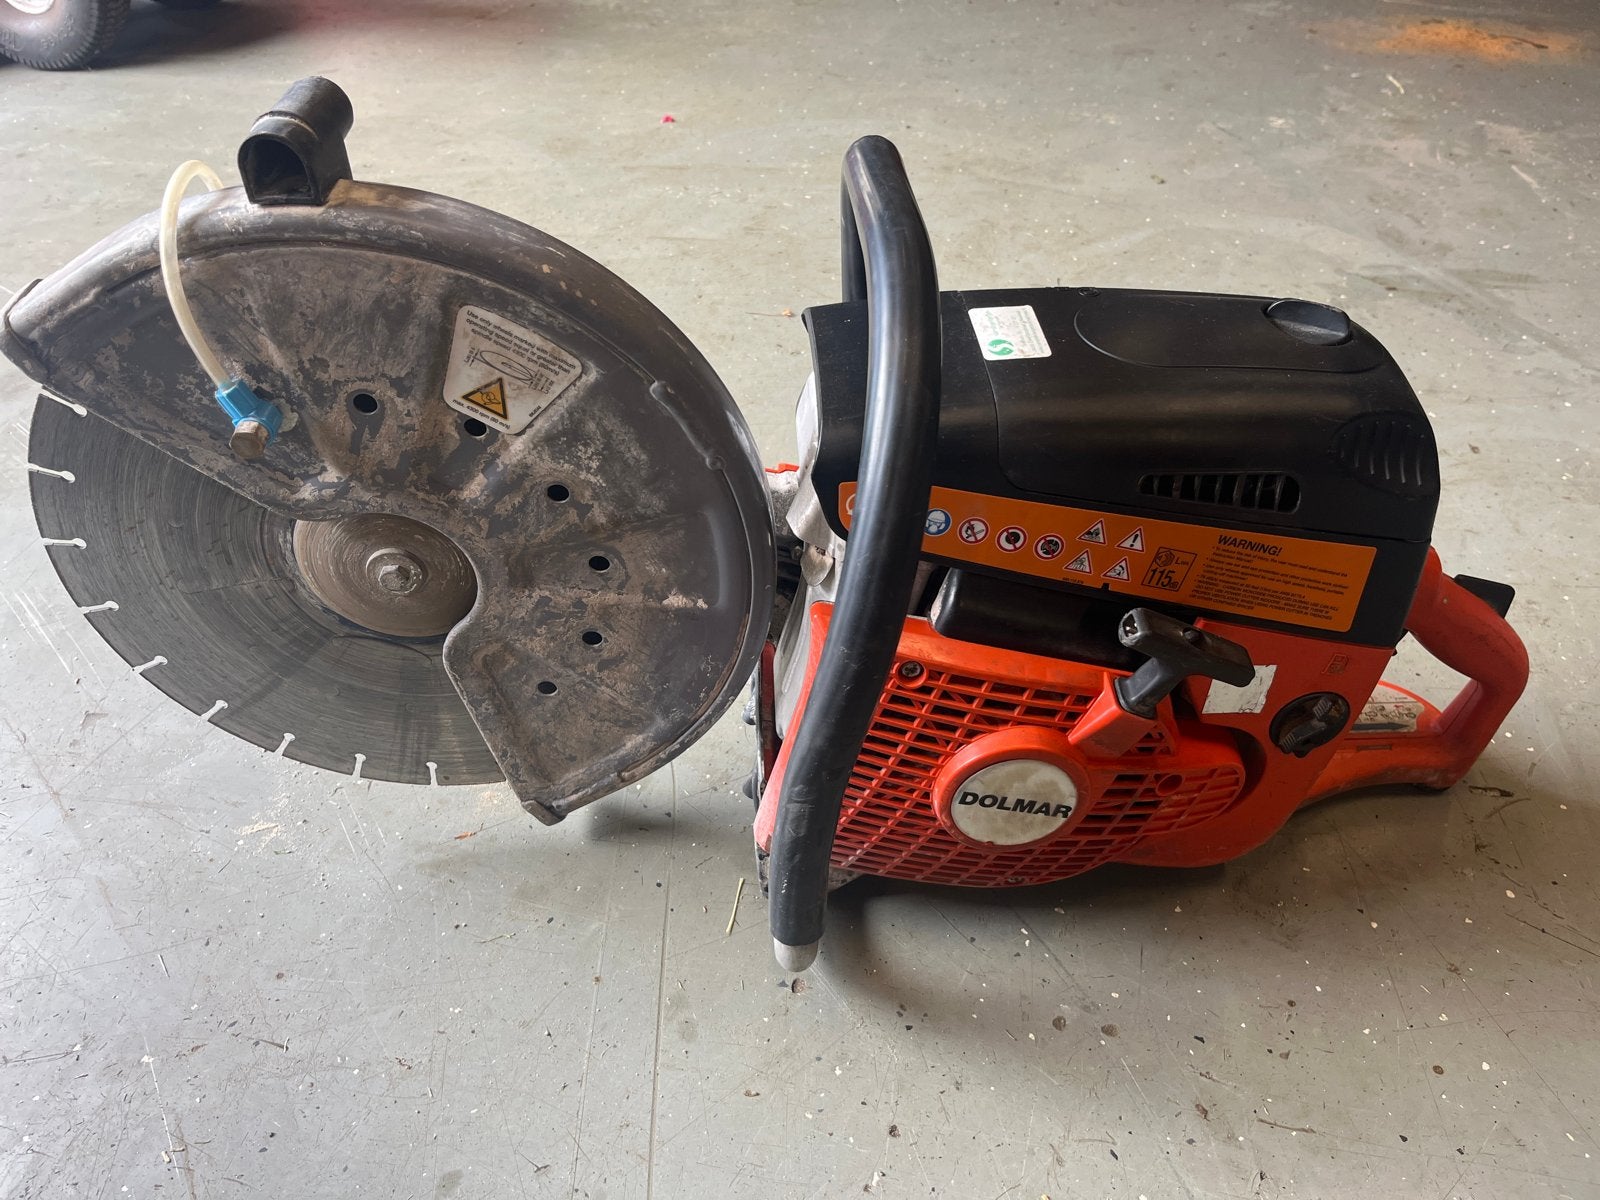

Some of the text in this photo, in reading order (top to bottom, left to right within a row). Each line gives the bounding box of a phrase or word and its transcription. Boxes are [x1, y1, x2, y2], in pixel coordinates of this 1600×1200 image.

[466, 318, 494, 335] operating
[495, 333, 513, 345] speed
[513, 342, 530, 353] equal
[537, 354, 558, 367] greater
[557, 364, 571, 374] than
[467, 310, 576, 370] Use only wheels marked with maximum
[471, 328, 492, 341] spindle
[493, 339, 512, 351] speed
[527, 356, 538, 365] rpm
[453, 399, 465, 408] max.
[466, 405, 479, 414] 4300
[479, 411, 490, 420] rpm
[1218, 535, 1283, 556] WARNING!
[1148, 567, 1176, 587] 115
[958, 791, 1072, 819] DOLMAR
